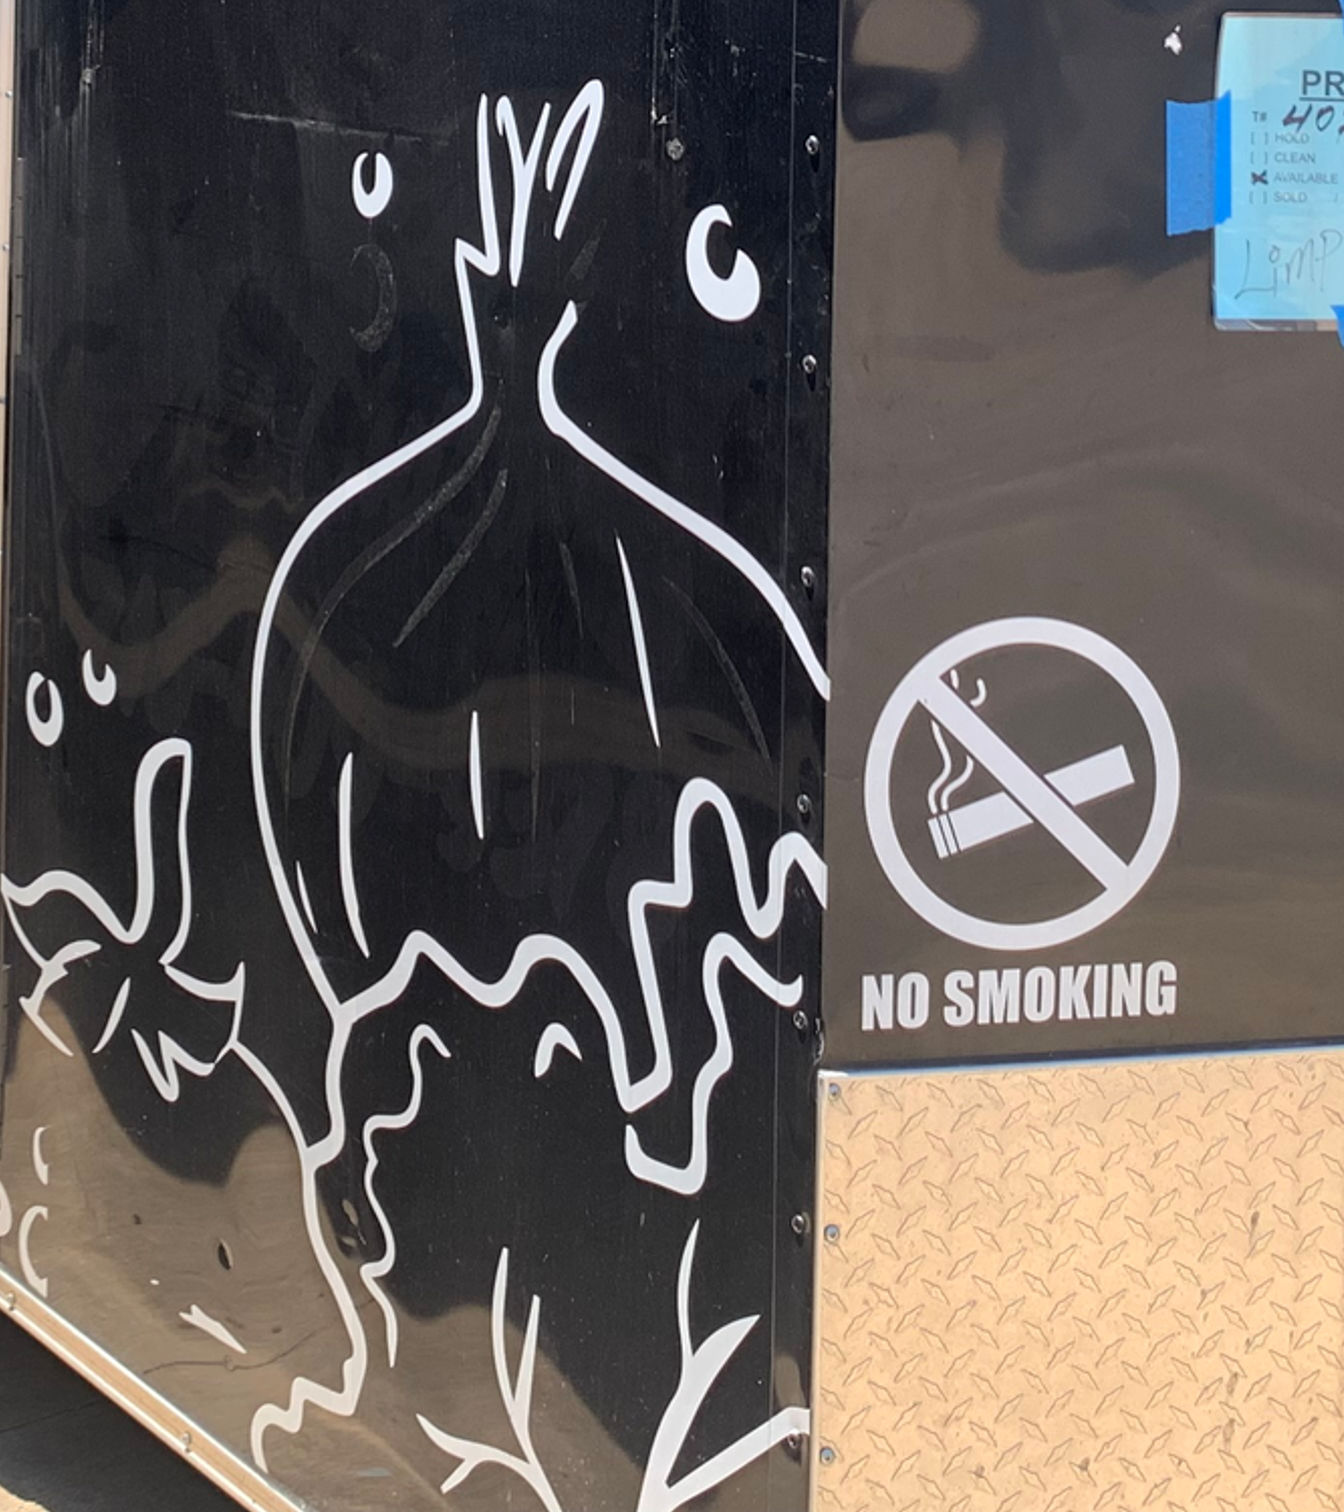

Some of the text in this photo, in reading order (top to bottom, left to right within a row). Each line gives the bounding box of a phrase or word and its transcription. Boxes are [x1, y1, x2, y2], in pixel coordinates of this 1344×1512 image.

[1275, 132, 1310, 144] HOLD
[1274, 152, 1316, 164] CLEAN
[1273, 172, 1339, 185] AVAILABLE
[1273, 191, 1308, 203] SOLD
[860, 959, 1177, 1031] NO SMOKING
